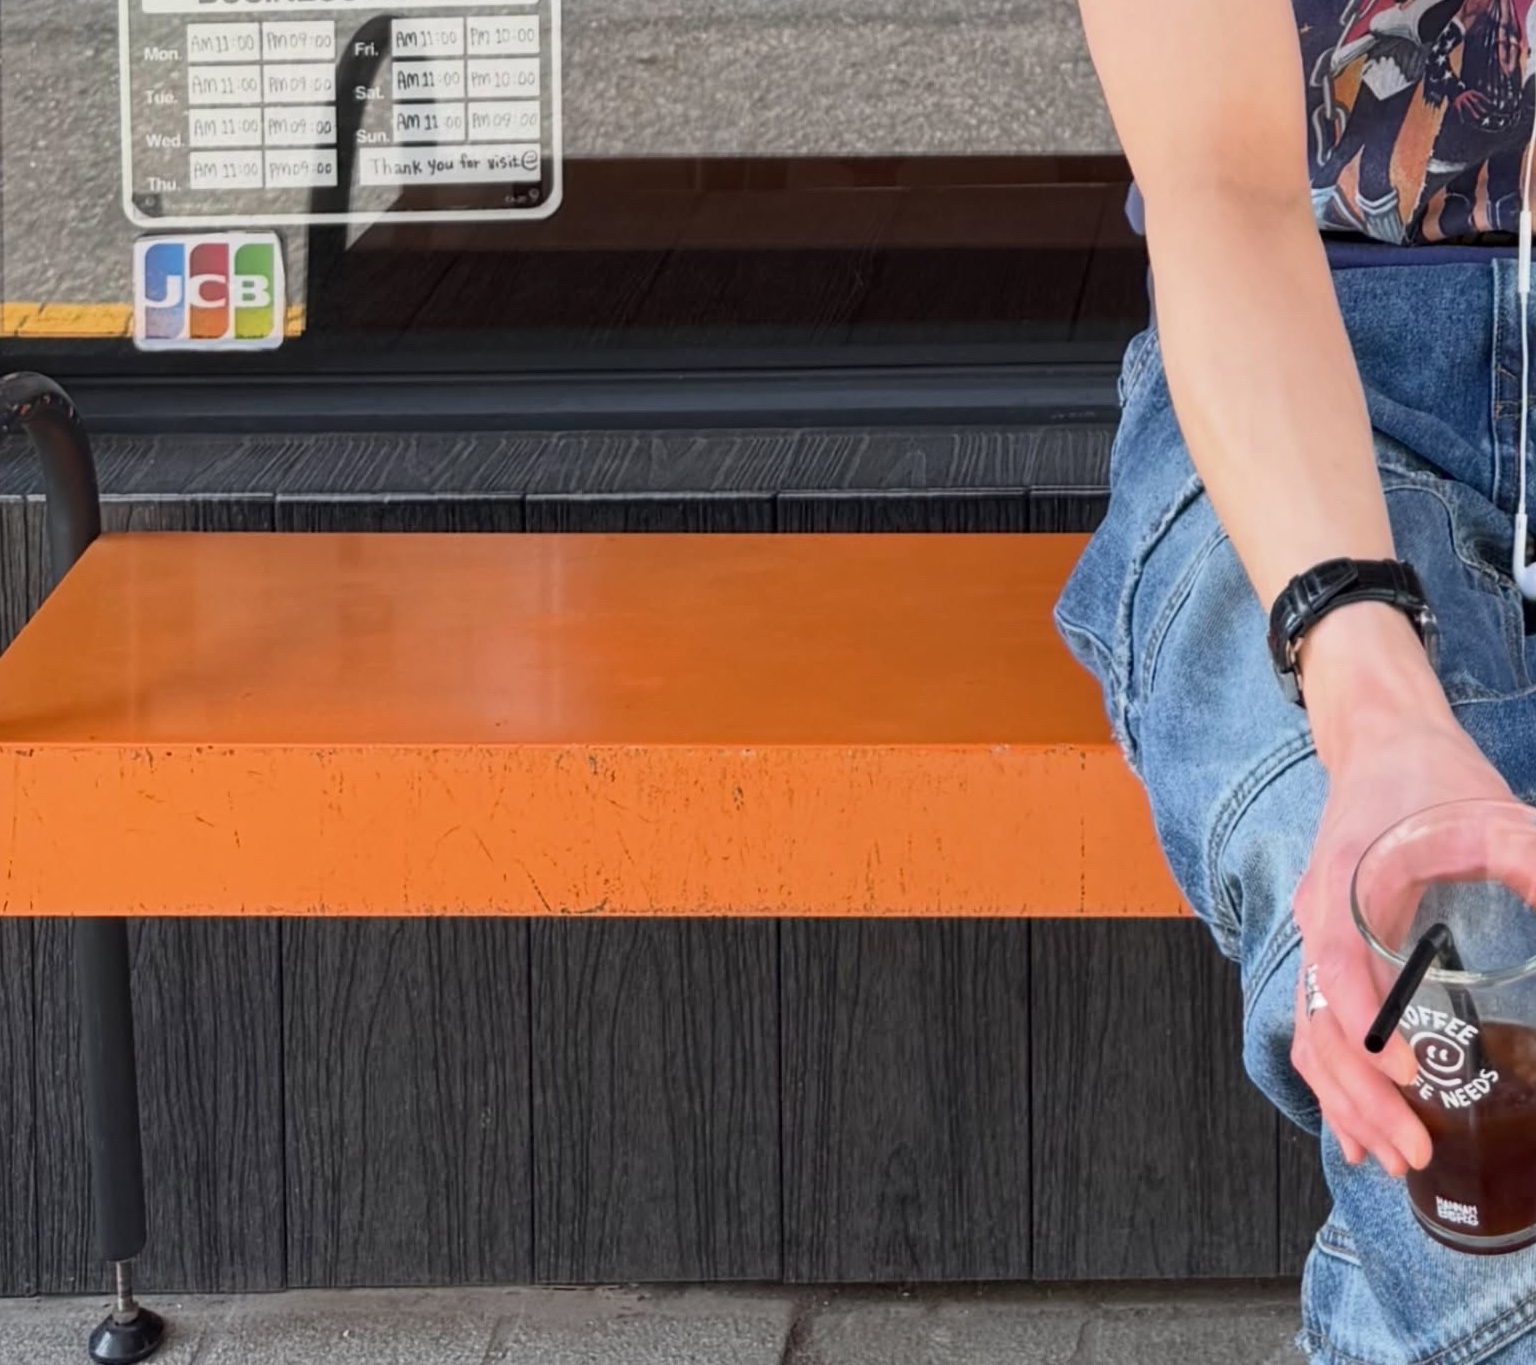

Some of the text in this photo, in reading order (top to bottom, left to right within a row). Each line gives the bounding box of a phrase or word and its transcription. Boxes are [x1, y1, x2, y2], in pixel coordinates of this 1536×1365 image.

[144, 47, 182, 61] Mon.
[354, 42, 378, 56] Fri.
[145, 90, 178, 104] Tue.
[355, 85, 385, 100] Sat.
[146, 133, 185, 147] Wed.
[356, 129, 390, 143] Sun.
[370, 153, 520, 176] Thank you for visit
[148, 177, 181, 191] Thu.
[142, 273, 270, 308] JCB
[1440, 1068, 1499, 1109] NEEDS
